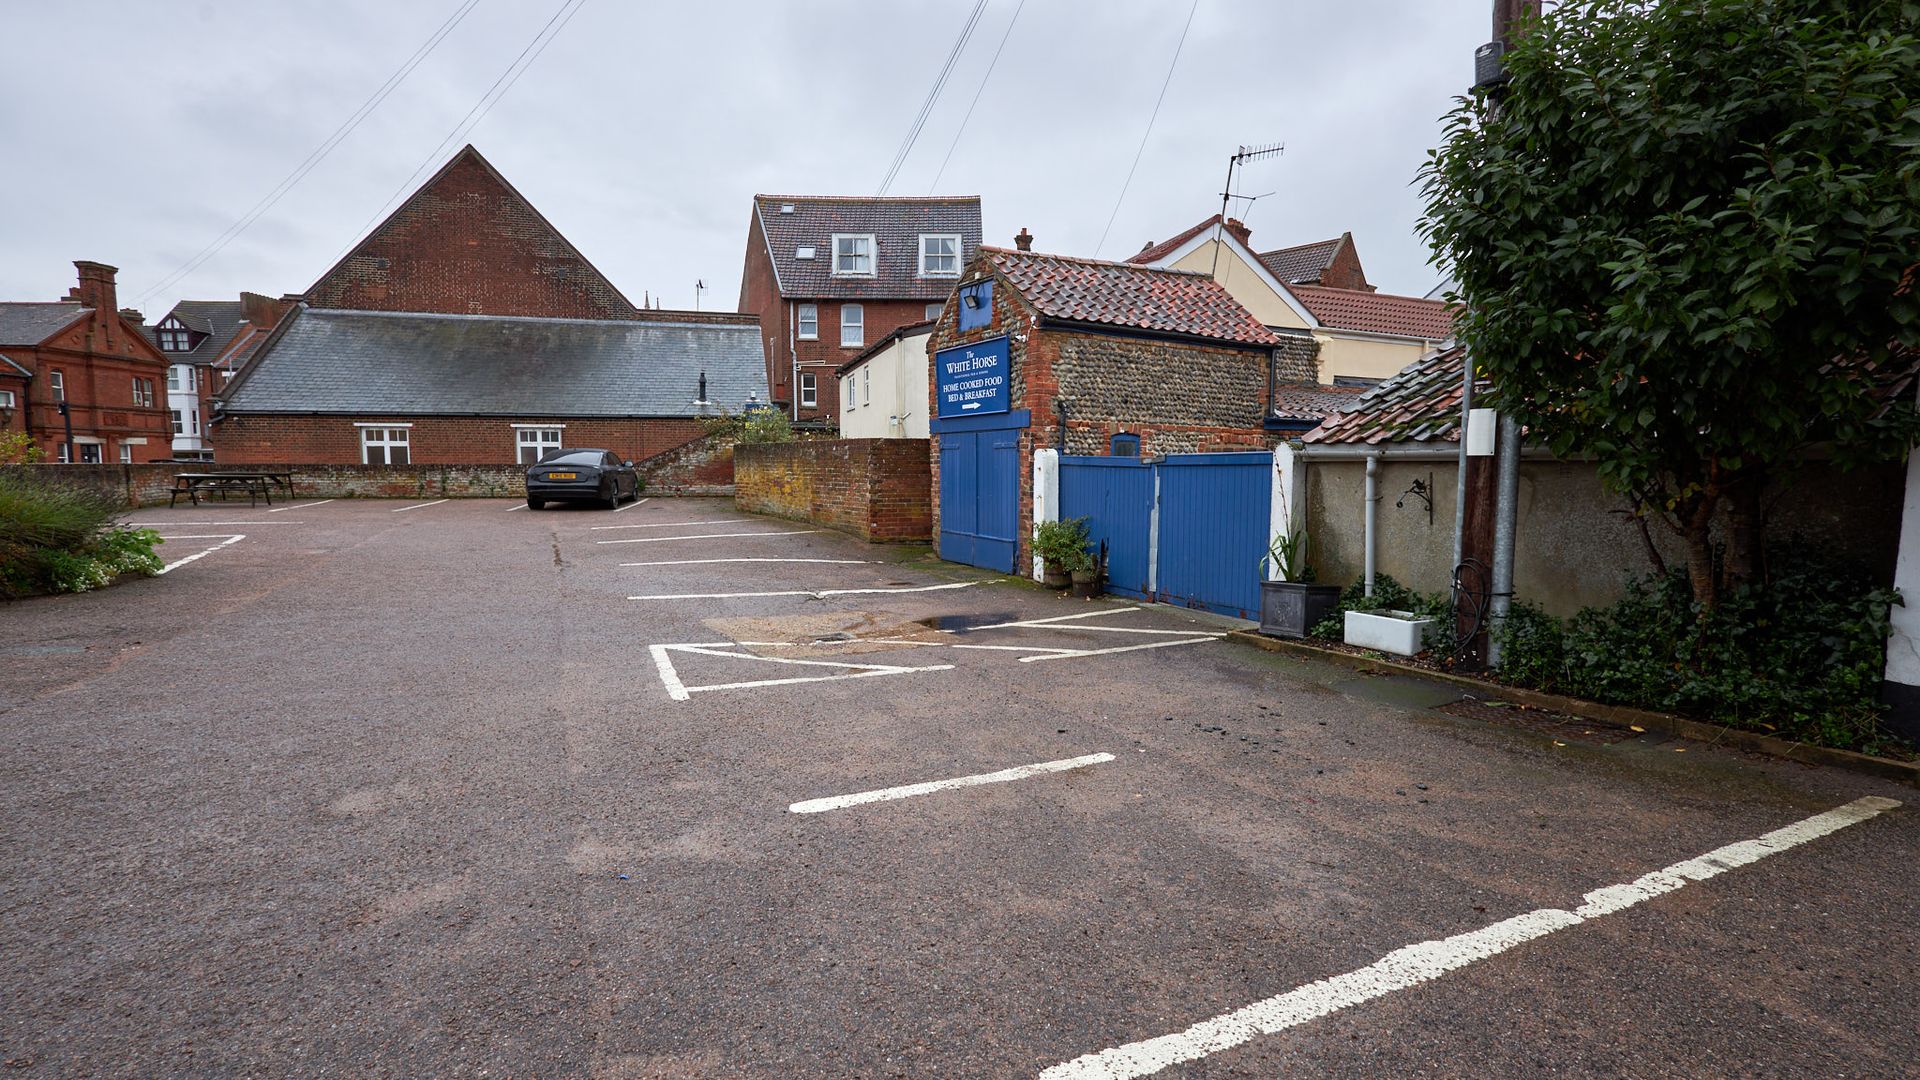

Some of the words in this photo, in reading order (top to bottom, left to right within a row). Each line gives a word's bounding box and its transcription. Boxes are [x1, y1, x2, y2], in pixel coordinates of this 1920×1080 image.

[966, 351, 974, 359] The
[946, 360, 970, 374] WHITE
[972, 355, 997, 370] HORSE
[943, 383, 959, 392] HOME
[960, 379, 984, 390] COOKED
[984, 376, 1002, 386] FOOD
[964, 388, 997, 400] BREAKFAST
